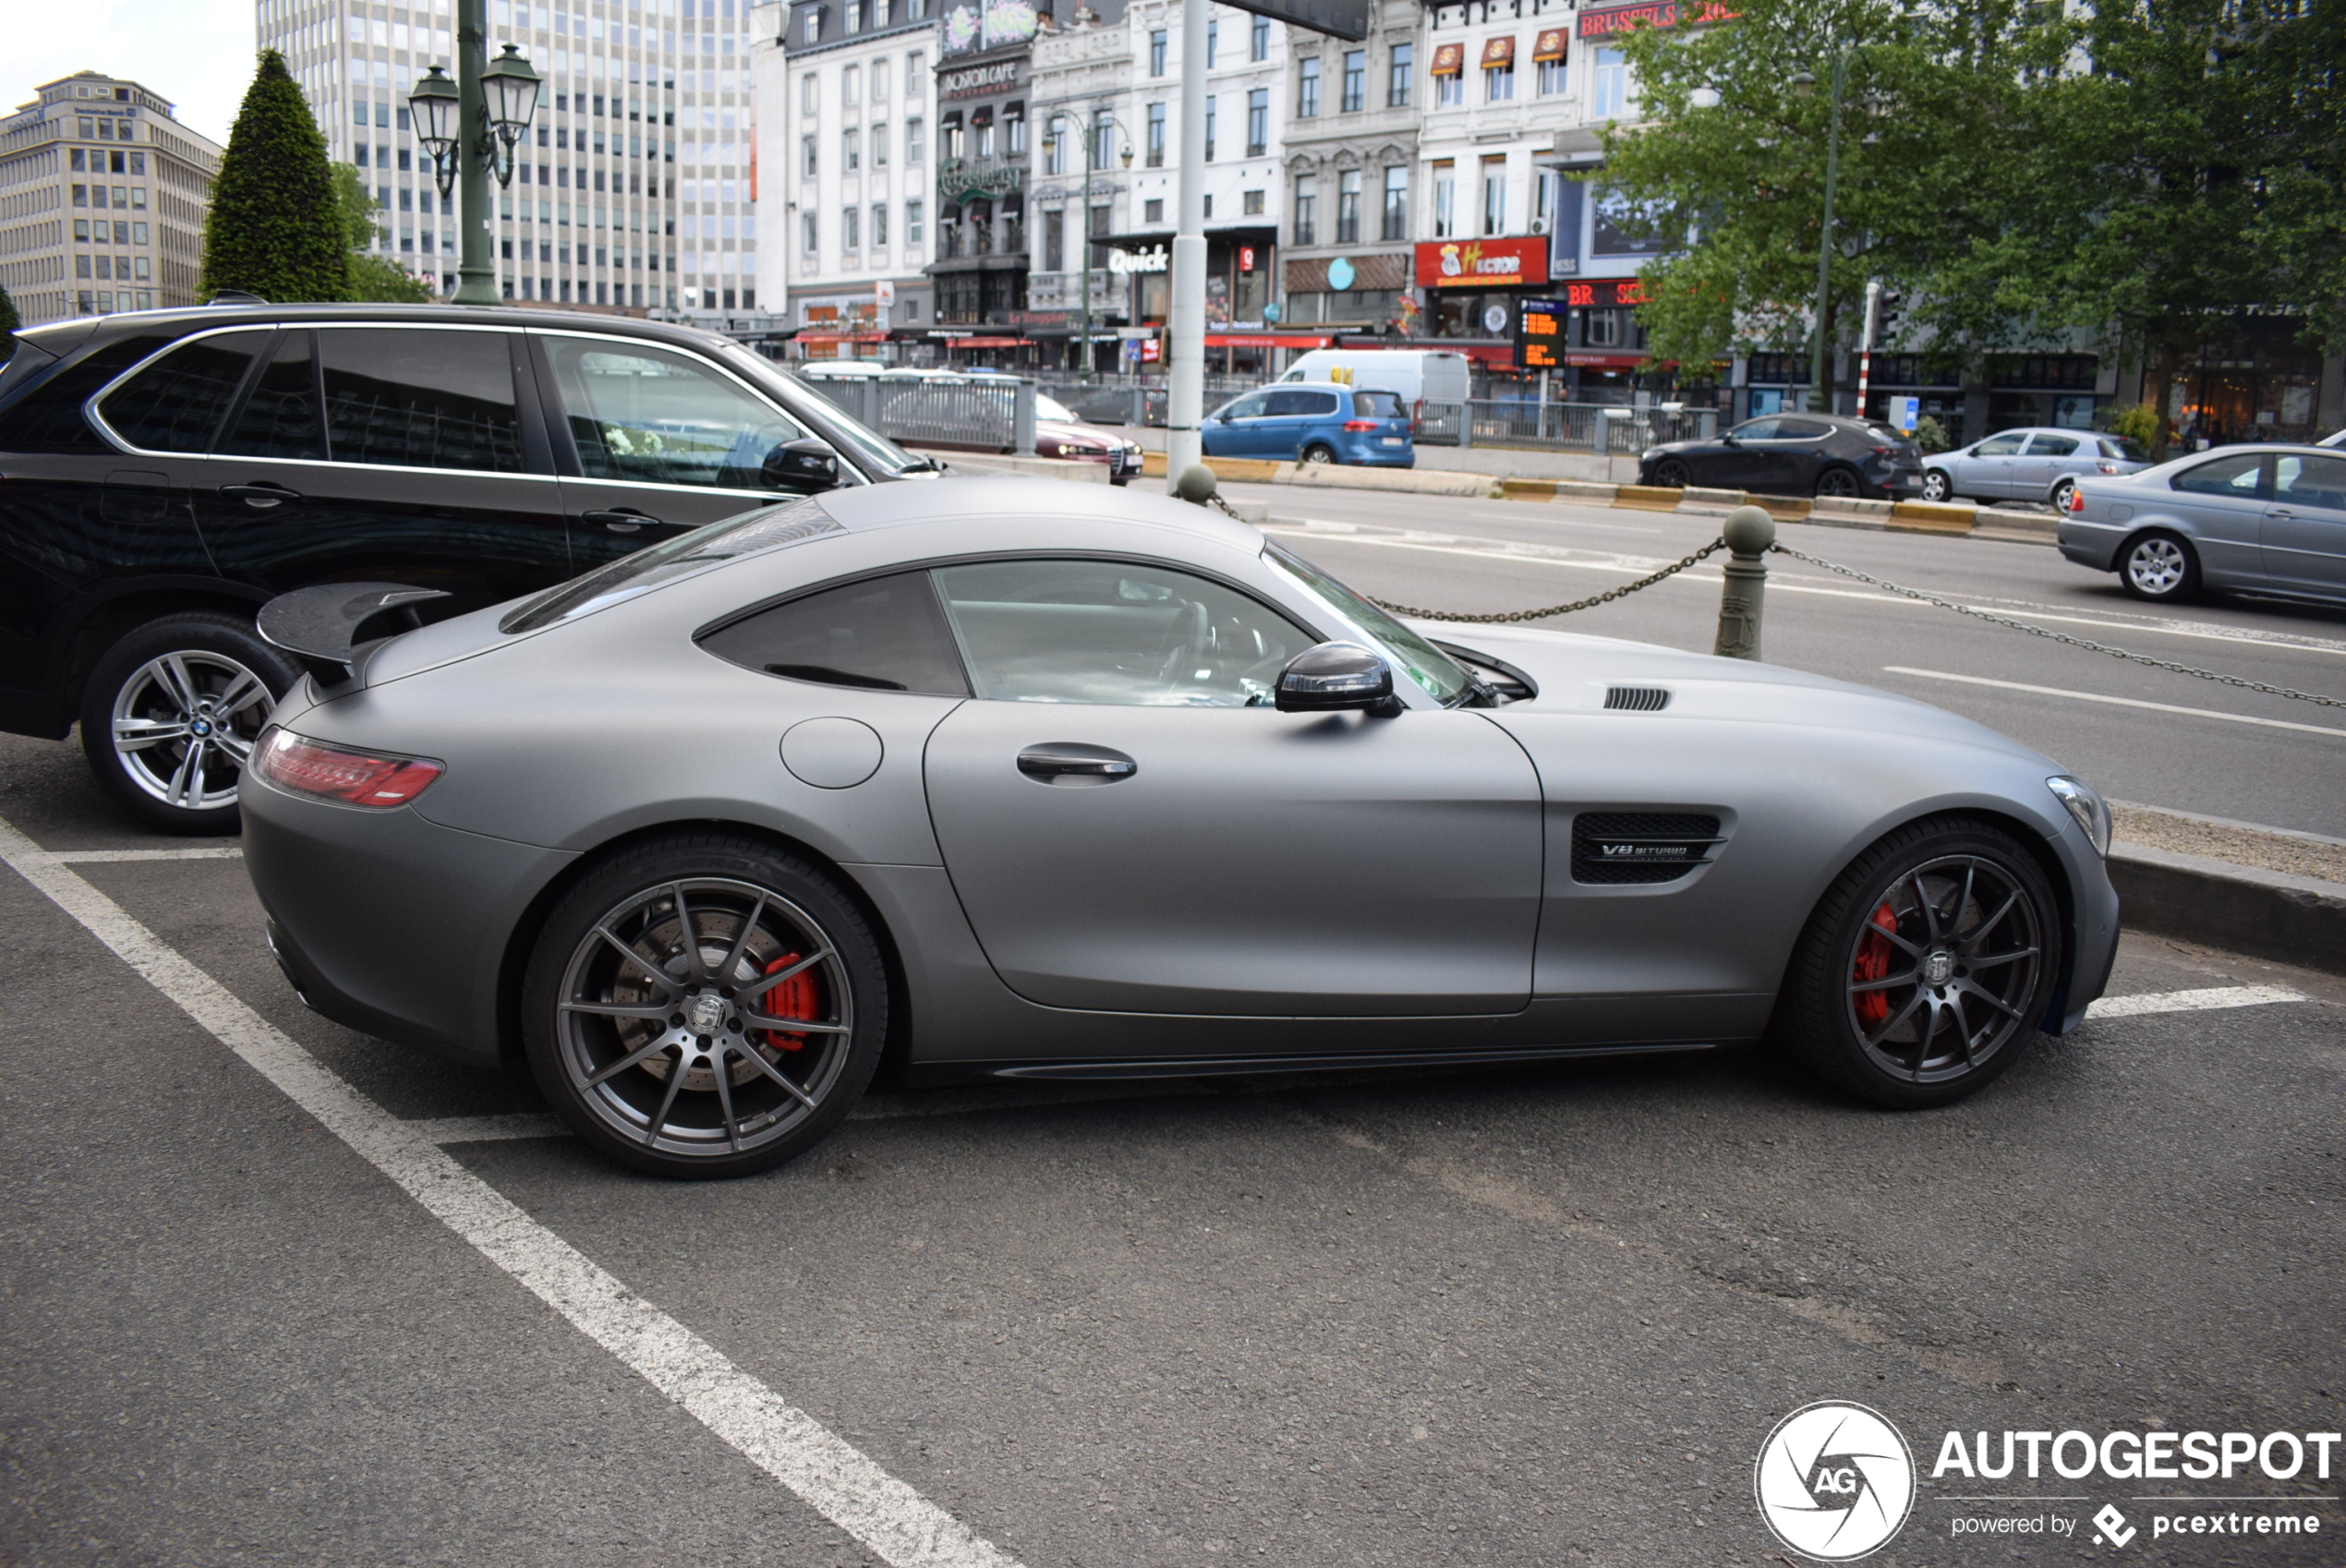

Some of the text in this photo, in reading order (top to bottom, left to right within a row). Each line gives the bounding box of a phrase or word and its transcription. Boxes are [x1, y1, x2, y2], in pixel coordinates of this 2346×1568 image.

[1580, 5, 1675, 37] BRUSSELS
[945, 67, 988, 92] BOSTON
[1109, 244, 1168, 274] Quick
[1243, 248, 1254, 262] Q
[1602, 845, 1687, 855] V8 BITURBO
